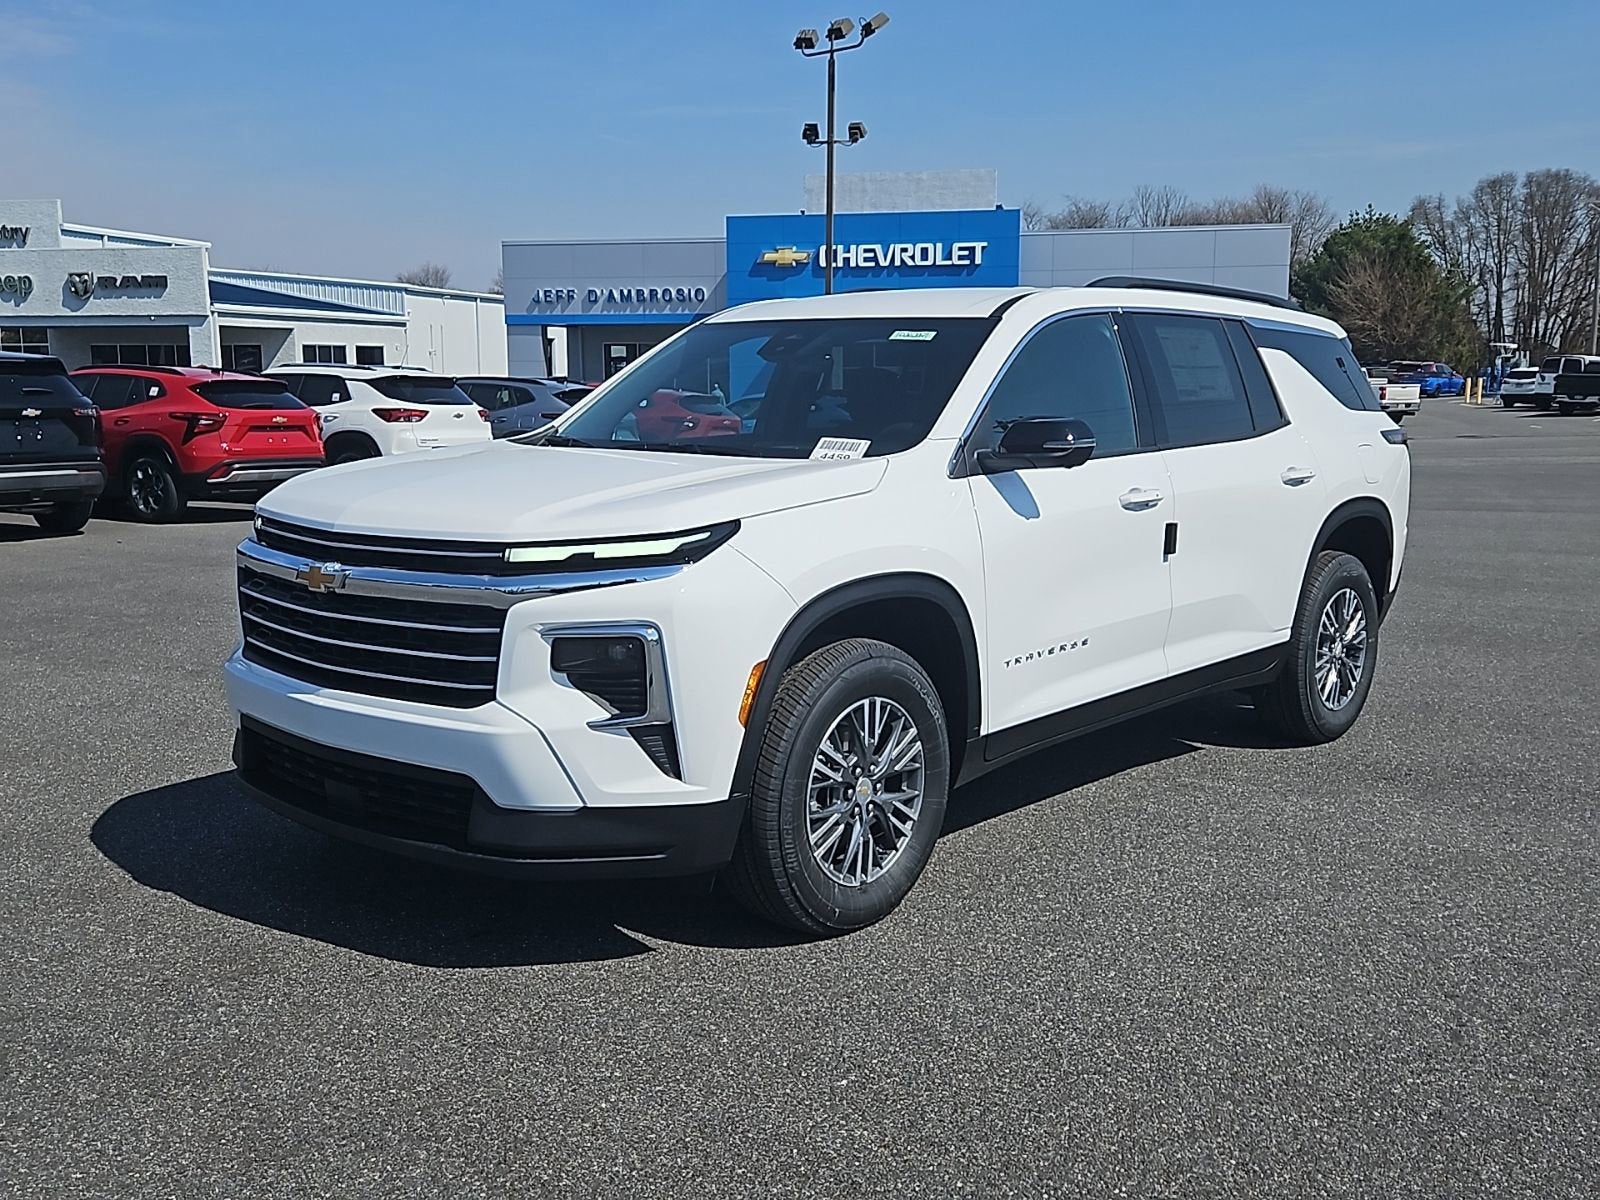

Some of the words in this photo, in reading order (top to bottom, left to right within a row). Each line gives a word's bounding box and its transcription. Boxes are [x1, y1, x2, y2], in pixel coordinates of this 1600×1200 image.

[0, 224, 31, 245] try
[819, 241, 988, 268] CHEVROLET
[97, 275, 168, 289] RAM
[532, 289, 577, 304] JEFF
[588, 288, 707, 304] D'AMBROSIO
[1004, 637, 1089, 668] TRAVERSE
